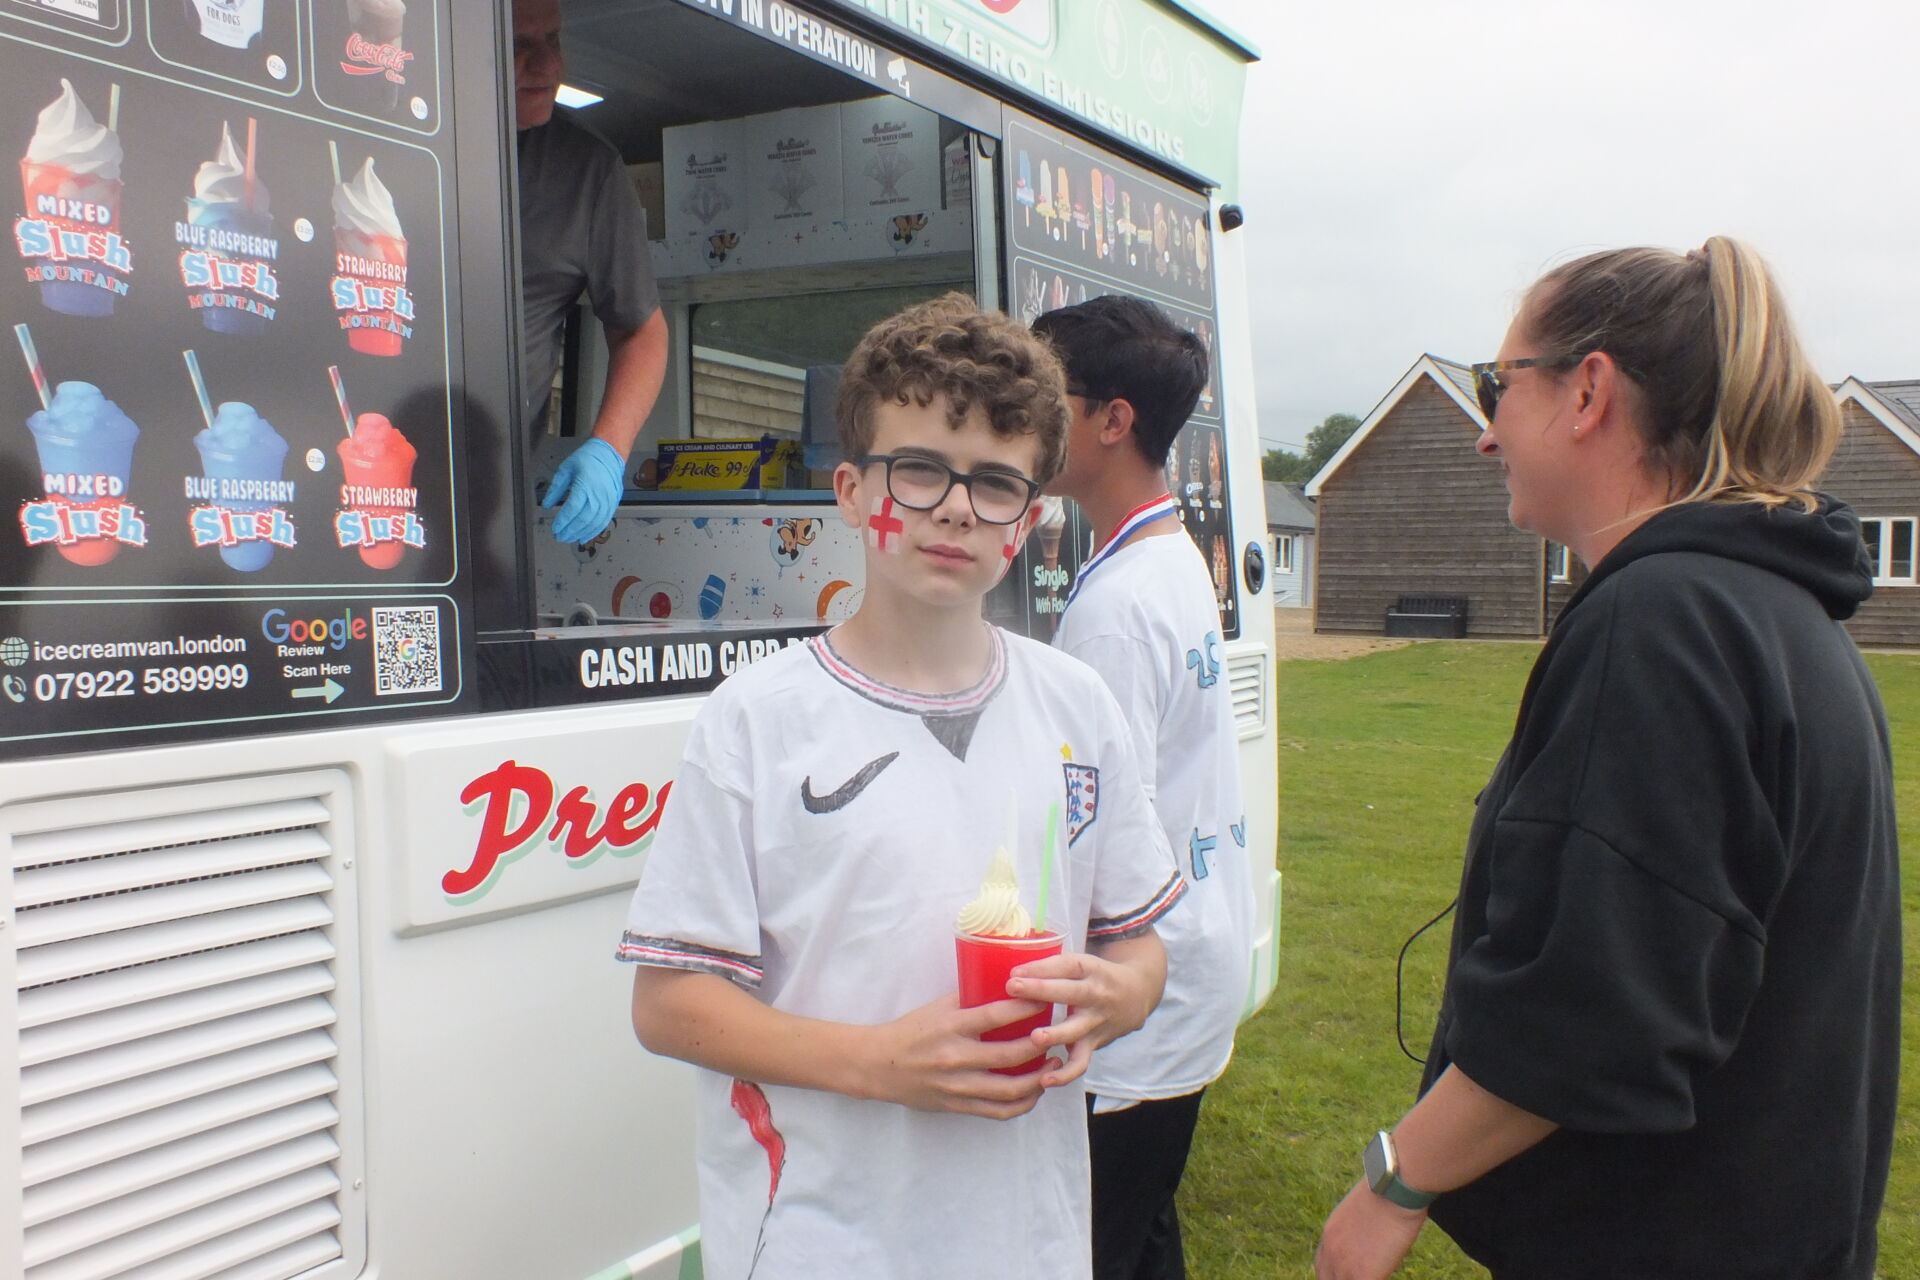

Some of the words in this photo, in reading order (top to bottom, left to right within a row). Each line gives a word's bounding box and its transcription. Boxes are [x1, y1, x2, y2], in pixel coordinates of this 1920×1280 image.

[207, 6, 220, 21] FOR
[222, 12, 241, 26] DOGS
[741, 0, 764, 29] IN
[770, 3, 877, 78] OPERATION
[943, 16, 1032, 82] ZERO
[1042, 70, 1185, 161] EMISSIONS
[37, 194, 111, 225] MIXED
[15, 217, 133, 274] Slush
[175, 221, 206, 246] BLUE
[209, 228, 279, 259] RASPBERRY
[25, 265, 129, 296] MOUNTAIN
[179, 250, 279, 300] Slush
[337, 253, 408, 283] STRAWBERRY
[188, 293, 276, 320] MOUNTAIN
[331, 276, 415, 321] Slush
[338, 314, 413, 339] MOUNTAIN
[44, 473, 123, 497] MIXED
[185, 476, 217, 499] BLUE
[221, 478, 295, 502] RASPBERRY
[342, 485, 418, 507] STRAWBERRY
[19, 500, 147, 548] Slush
[190, 504, 297, 548] Slush
[334, 510, 426, 549] Slush
[1034, 565, 1069, 592] Single
[1035, 596, 1051, 614] With
[262, 607, 367, 650] Google
[34, 635, 247, 661] icecreamvan.london
[278, 644, 325, 657] Review
[283, 665, 318, 678] Scan
[321, 664, 351, 676] Here
[580, 646, 654, 688] CASH
[661, 643, 713, 681] AND
[35, 670, 135, 702] 07922
[143, 664, 249, 694] 589999
